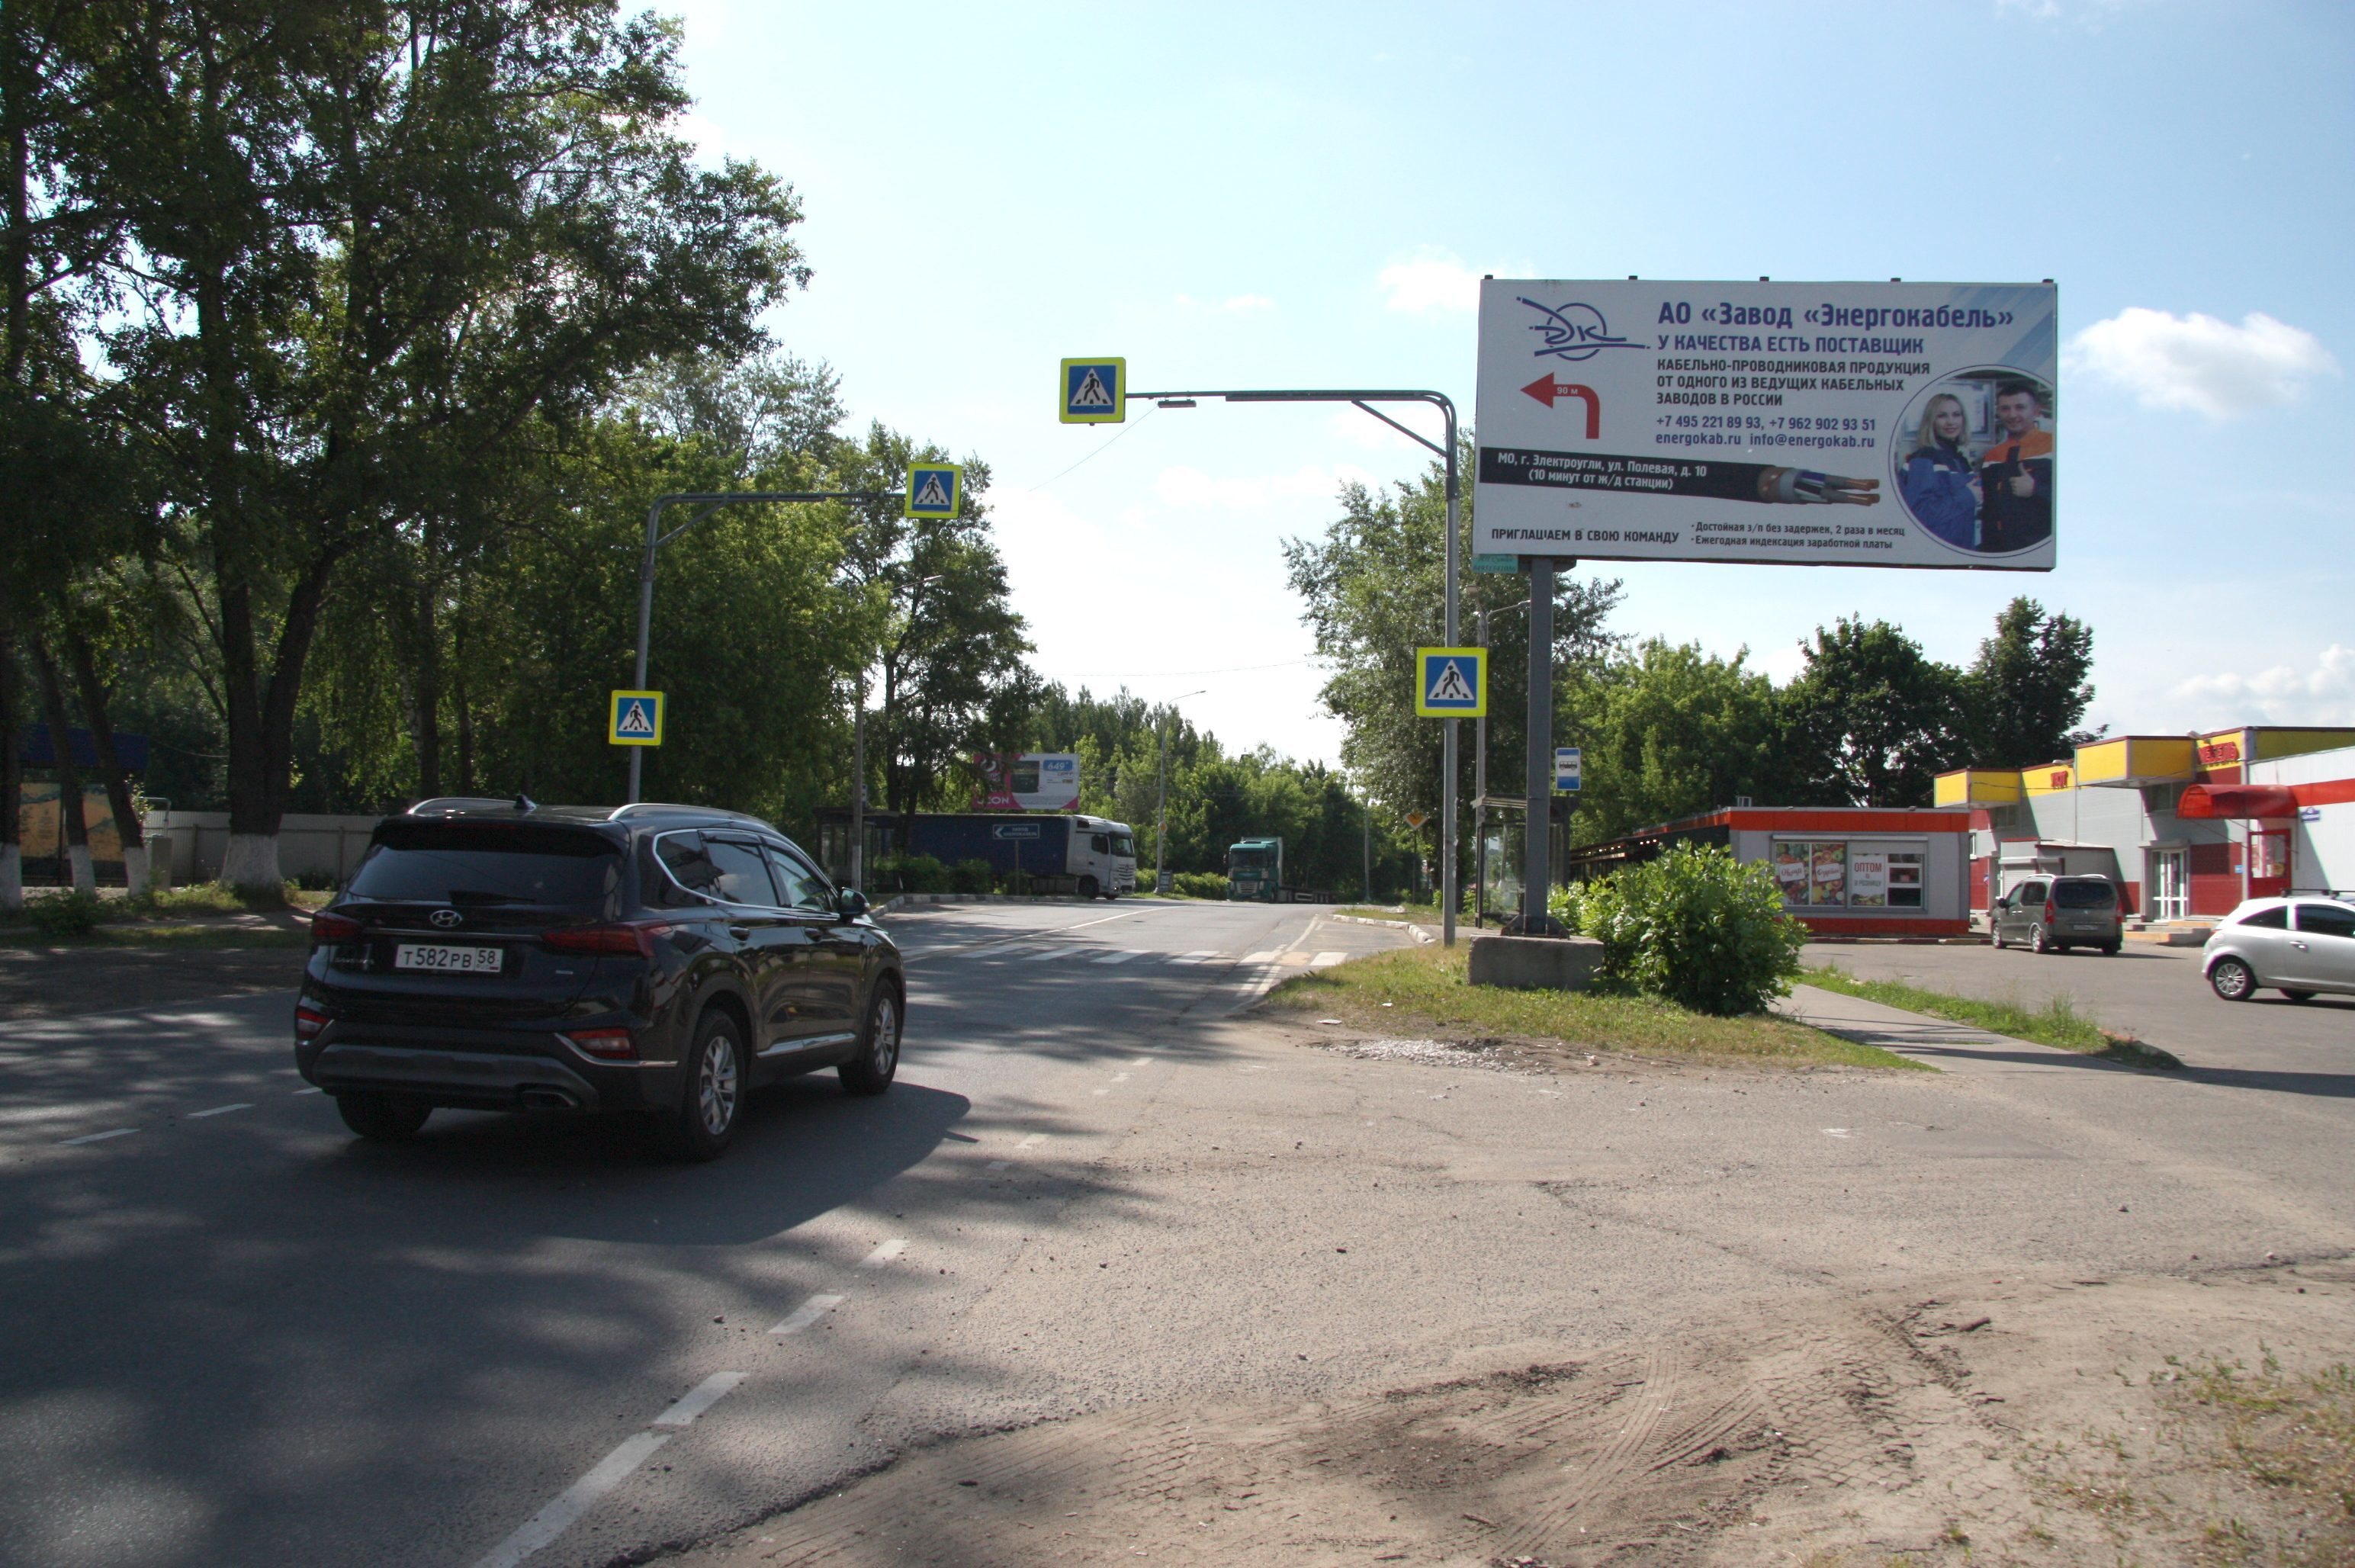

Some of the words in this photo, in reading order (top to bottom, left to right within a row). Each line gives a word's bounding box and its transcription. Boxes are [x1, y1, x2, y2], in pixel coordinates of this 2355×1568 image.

[1658, 302, 1691, 324] АО
[1701, 302, 1793, 329] «Завод
[1804, 303, 2014, 331] «Энергокабель»
[1658, 335, 1669, 350] У
[1675, 335, 1762, 352] КАЧЕСТВА
[1768, 336, 1810, 352] ЕСТЬ
[1816, 337, 1924, 355] ПОСТАВЩИК
[1657, 358, 1846, 374] КАБЕЛЬНО-ПРОВОДНИКОВАЯ
[1850, 361, 1930, 376] ПРОДУКЦИЯ
[1657, 375, 1673, 387] ОТ
[1678, 375, 1727, 389] ОДНОГО
[1731, 377, 1746, 388] ИЗ
[1751, 377, 1817, 391] ВЕДУЩИХ
[1821, 378, 1904, 391] КАБЕЛЬНЫХ
[1656, 392, 1716, 406] ЗАВОДОВ
[1720, 394, 1730, 405] В
[1733, 394, 1782, 406] РОССИИ
[1656, 415, 1672, 427] +7
[1675, 416, 1698, 428] 495
[1702, 416, 1723, 428] 221
[1727, 416, 1742, 429] 89
[1746, 416, 1765, 430] 93,
[1769, 417, 1785, 429] +7
[1788, 417, 1811, 429] 962
[1816, 418, 1839, 430] 902
[1843, 419, 1858, 431] 93
[1862, 419, 1875, 431] 51
[1656, 432, 1741, 446] energokab.ru
[1750, 433, 1875, 448] info@energokab.ru
[1498, 451, 1518, 466] МО,
[1521, 455, 1530, 465] г.
[1533, 455, 1605, 471] Электроугли,
[1608, 461, 1624, 472] ул.
[1627, 461, 1678, 477] Полевая,
[1680, 466, 1692, 477] д.
[1695, 465, 1708, 477] 10
[1528, 468, 1545, 481] (10
[1548, 471, 1580, 484] минут
[1583, 474, 1595, 484] от
[1598, 474, 1622, 487] ж/д
[1624, 476, 1674, 490] станции)
[1491, 529, 1571, 541] ПРИГЛАШАЕМ
[1575, 529, 1583, 541] В
[1587, 530, 1620, 541] СВОЮ
[1624, 531, 1679, 544] КОМАНДУ
[1695, 521, 1745, 532] Достойная
[1747, 522, 1763, 534] з/п
[1765, 523, 1782, 533] без
[1784, 524, 1833, 535] задержек,
[1836, 525, 1842, 534] 2
[1844, 526, 1865, 535] раза
[1876, 527, 1905, 537] месяц
[1695, 535, 1747, 546] Ежегодная
[1749, 537, 1804, 548] индексация
[1807, 538, 1861, 548] заработной
[1862, 540, 1893, 549] платы
[1854, 862, 1882, 872] ОПТОМ
[477, 949, 496, 965] 58
